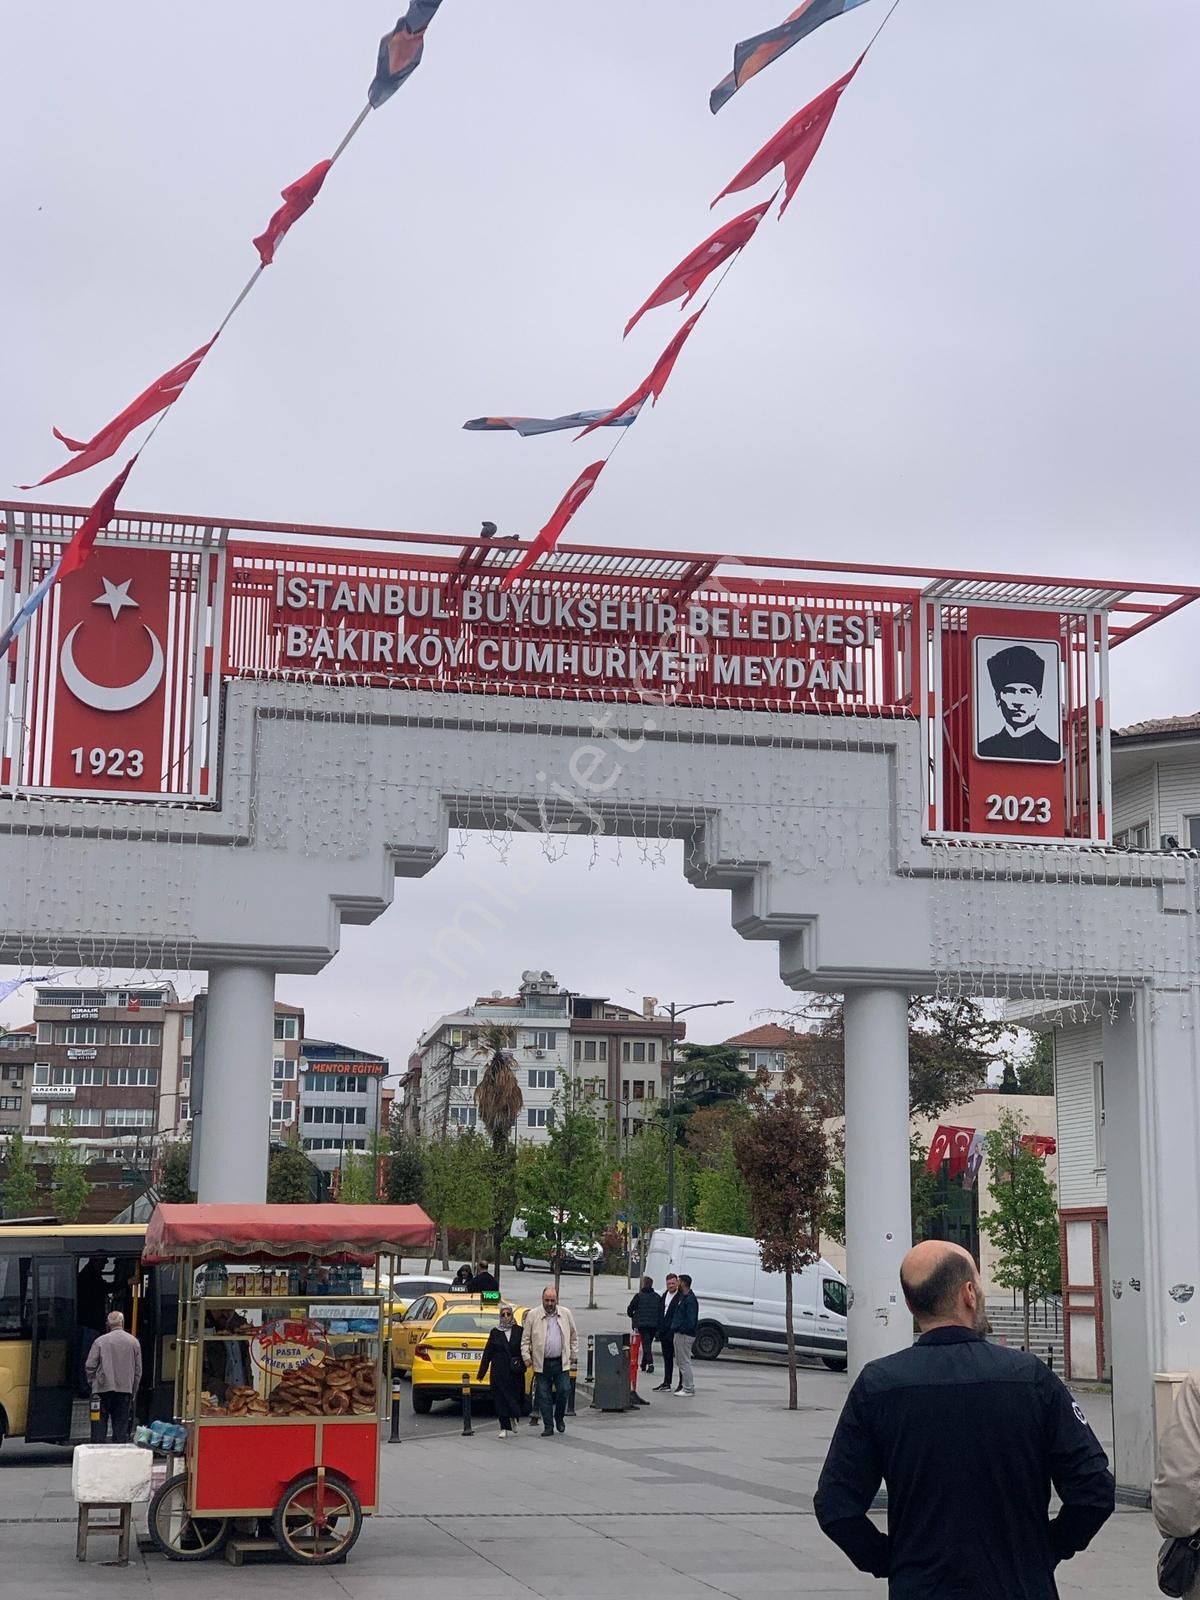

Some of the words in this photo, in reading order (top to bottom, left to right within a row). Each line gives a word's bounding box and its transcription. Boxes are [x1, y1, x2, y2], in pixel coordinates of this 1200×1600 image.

[275, 567, 450, 620] İSTANBUL
[461, 583, 678, 636] BÜYÜKŞEHİR
[689, 604, 875, 649] BELEDİYESİ
[286, 624, 467, 668] BAKIRKÖY
[477, 639, 700, 684] CUMHURİYET
[712, 653, 865, 694] MEYDANI
[71, 746, 144, 778] 1923
[985, 793, 1052, 824] 2023
[312, 1063, 350, 1074] MENTOR
[276, 1348, 302, 1356] PASTA
